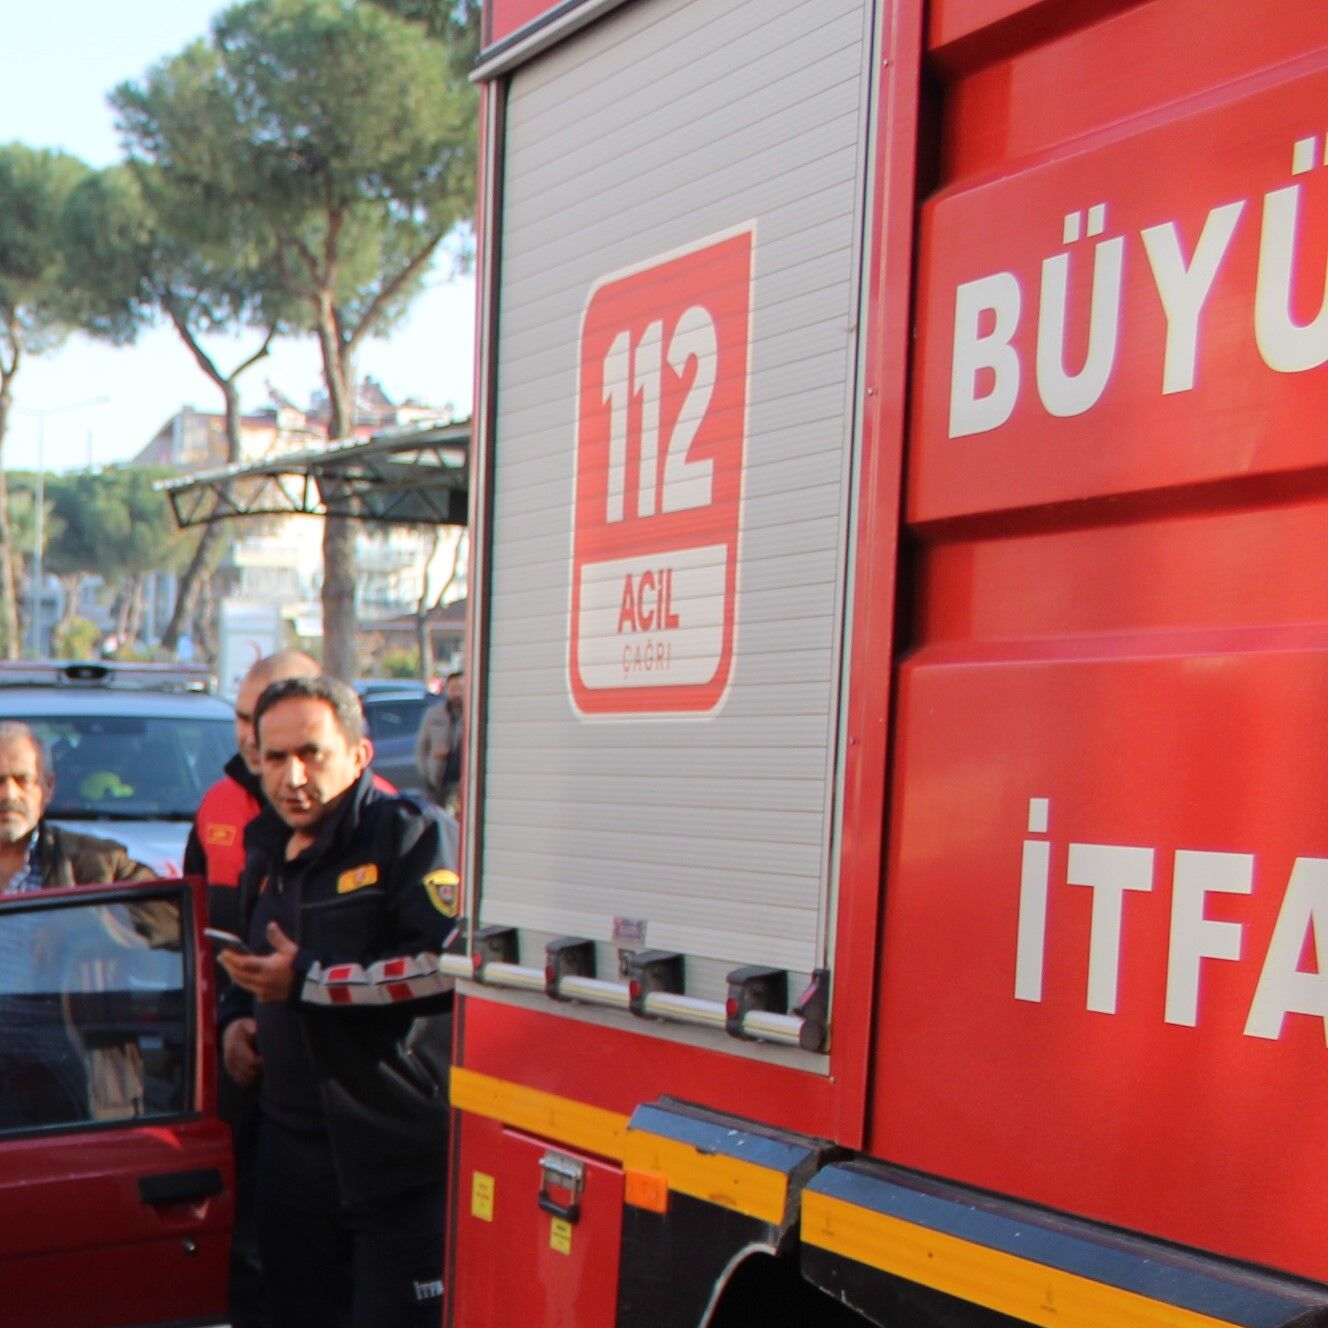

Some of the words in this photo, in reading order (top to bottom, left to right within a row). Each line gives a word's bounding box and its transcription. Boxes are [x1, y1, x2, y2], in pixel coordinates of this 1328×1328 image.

[601, 304, 719, 525] 112
[617, 567, 680, 635] ACİL
[622, 638, 674, 680] ÇAĞRI
